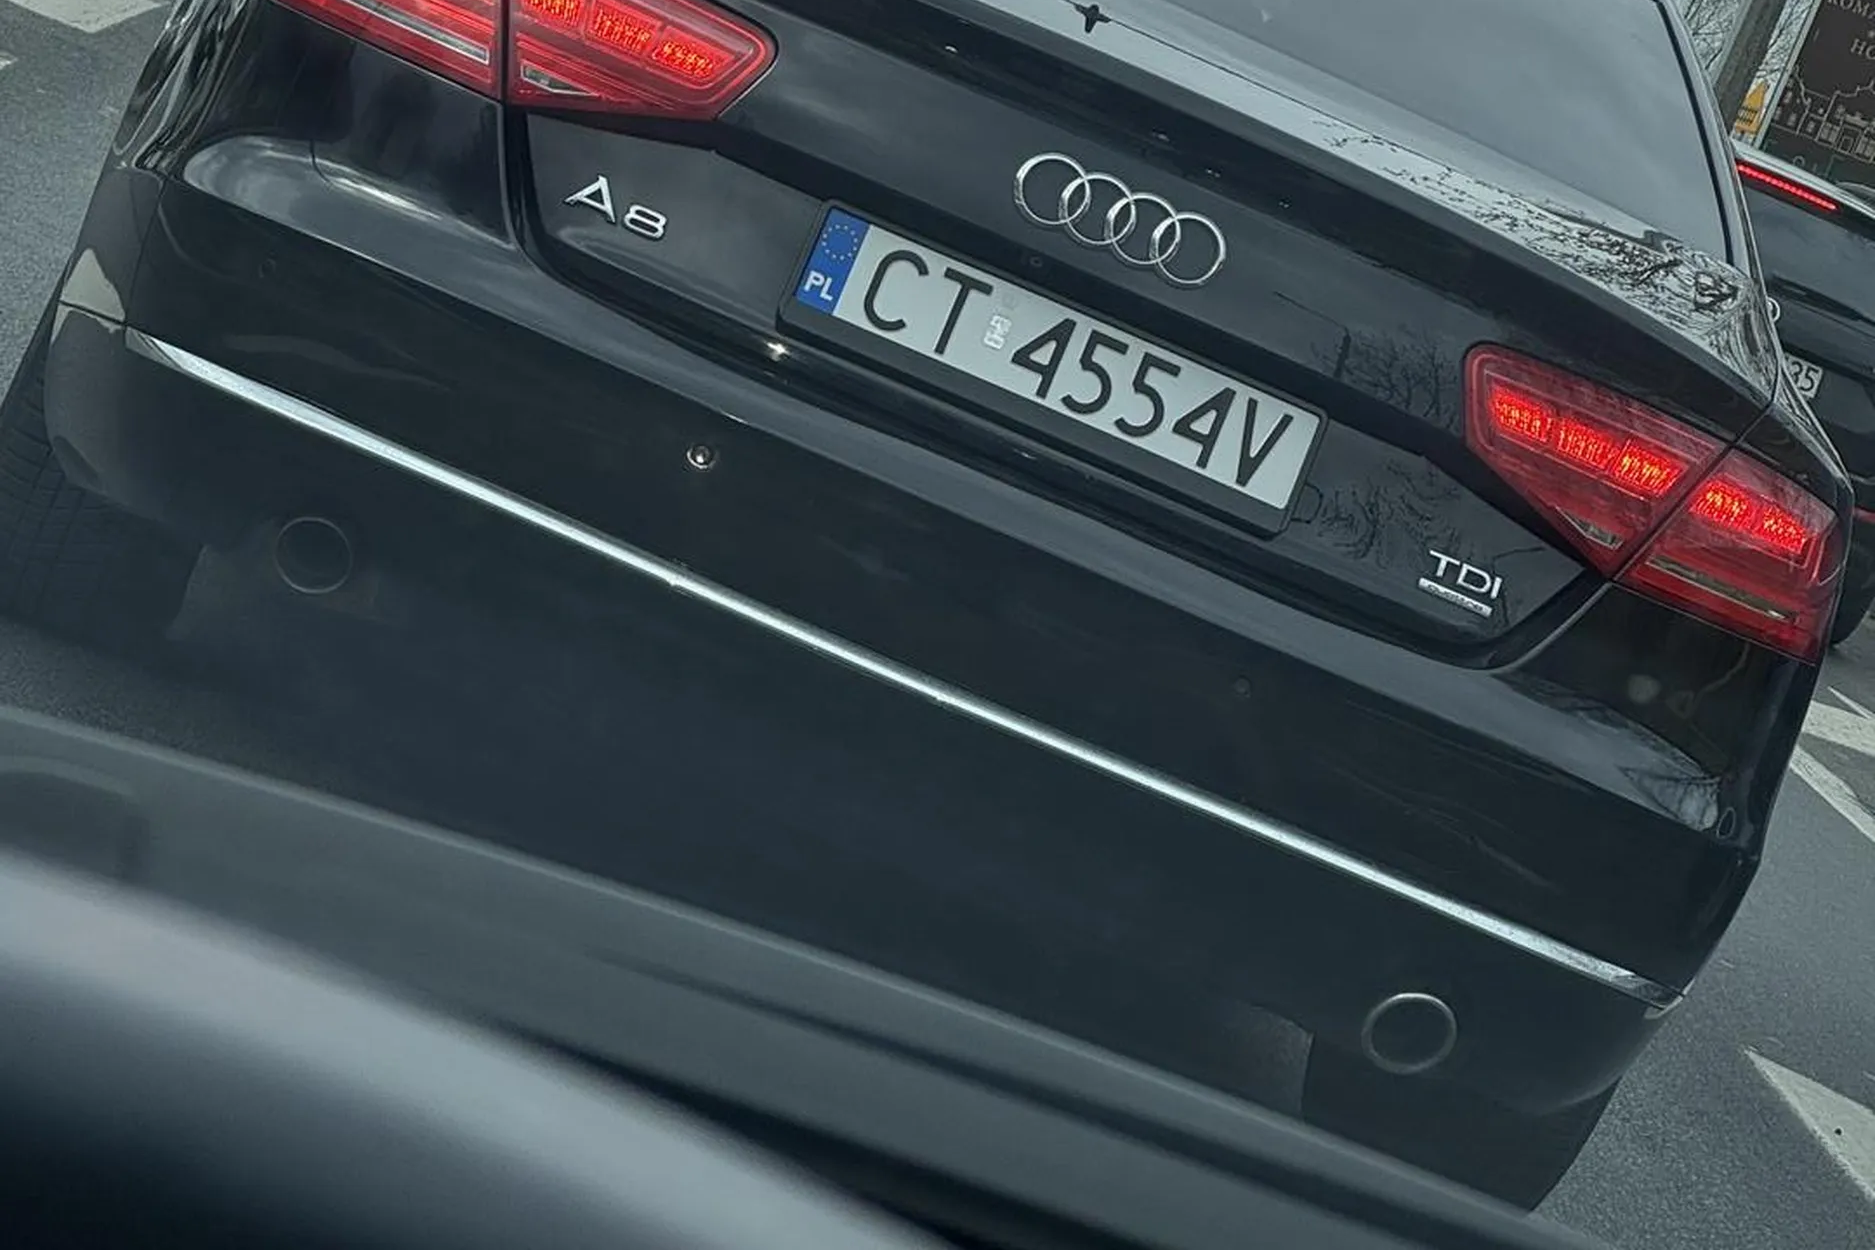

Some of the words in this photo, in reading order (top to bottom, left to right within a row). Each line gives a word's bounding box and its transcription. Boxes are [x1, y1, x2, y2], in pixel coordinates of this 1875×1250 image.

[563, 174, 667, 239] A8
[803, 269, 833, 301] PL
[863, 249, 994, 355] CT
[1010, 318, 1294, 488] 4554V
[1785, 354, 1819, 392] 35
[1428, 550, 1502, 599] TDI
